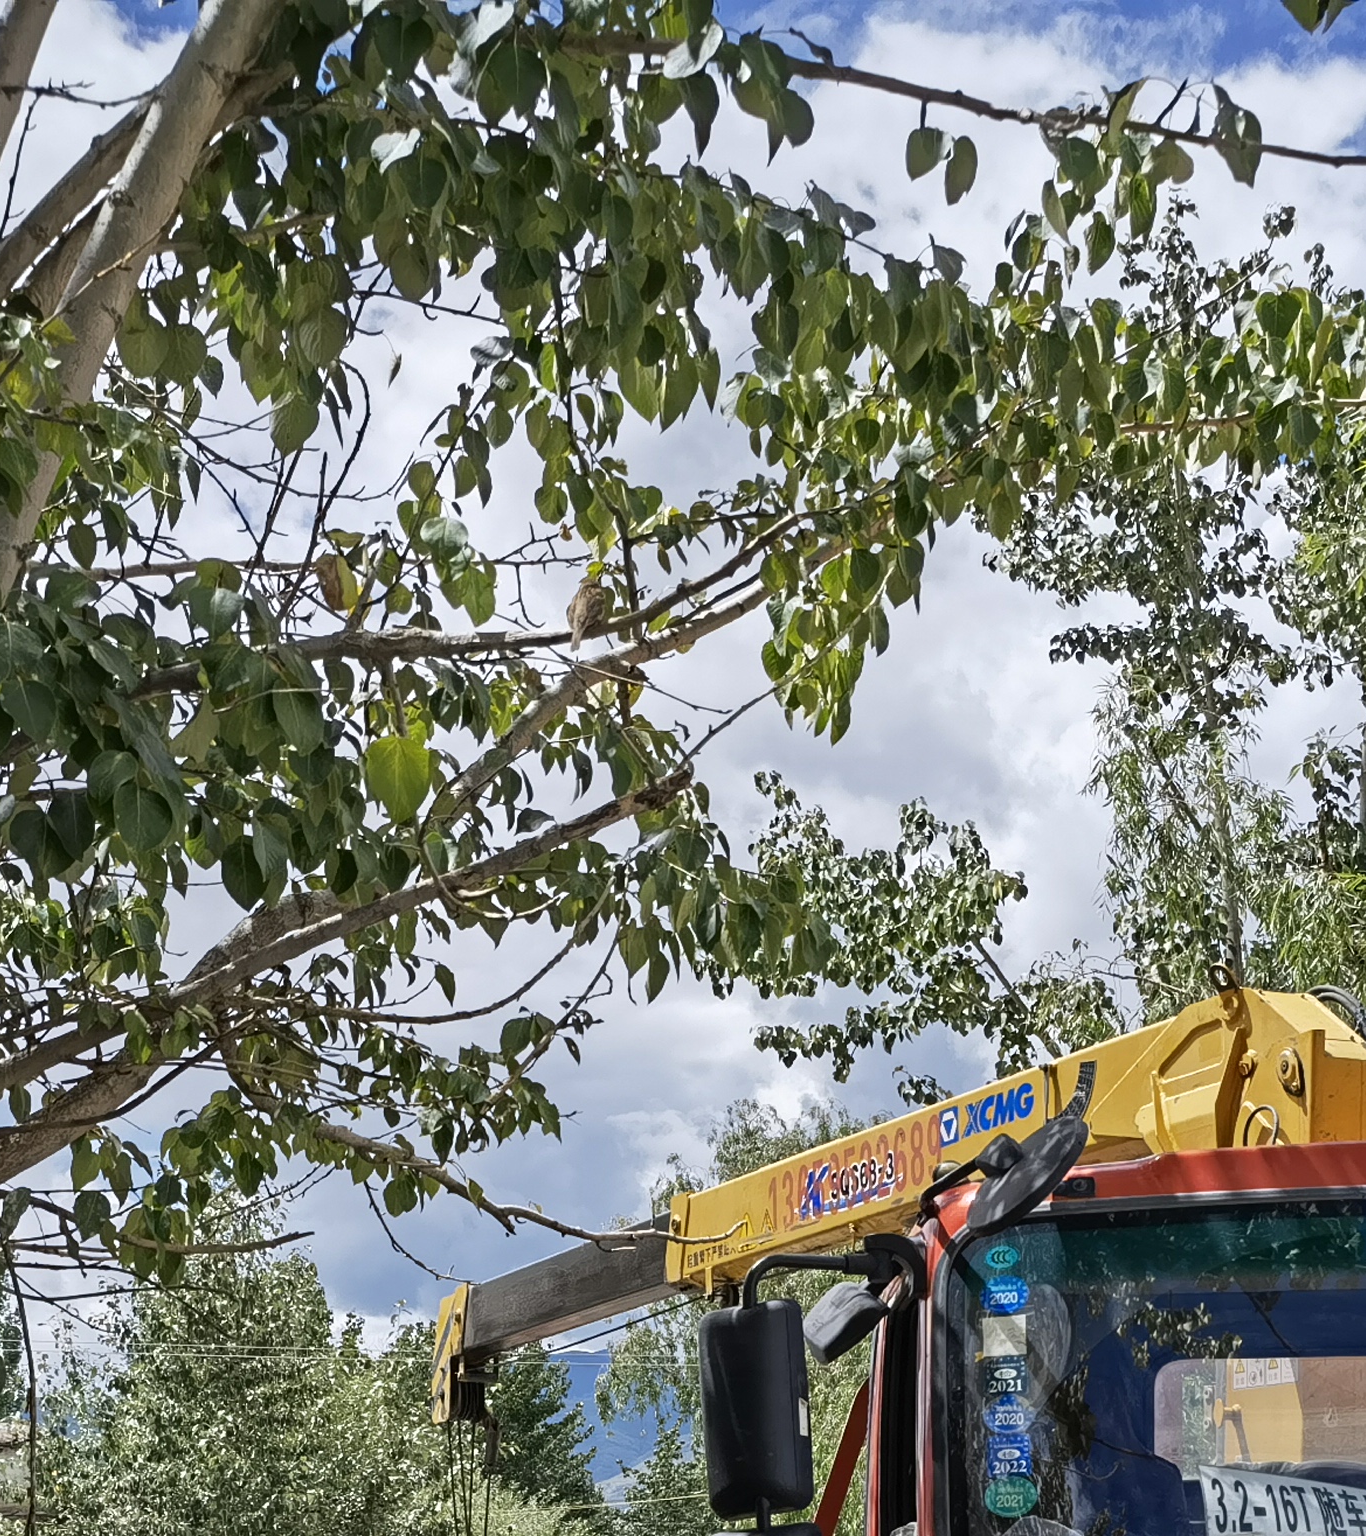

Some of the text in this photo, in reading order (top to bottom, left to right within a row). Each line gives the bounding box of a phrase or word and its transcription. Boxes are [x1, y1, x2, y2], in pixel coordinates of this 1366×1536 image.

[962, 1083, 1034, 1138] XCMG
[989, 1291, 1019, 1305] 2020
[988, 1378, 1023, 1394] 2021
[995, 1412, 1025, 1426] 2020
[992, 1460, 1028, 1475] 2022
[995, 1494, 1025, 1508] 2021
[1211, 1478, 1312, 1534] 3.2-16T
